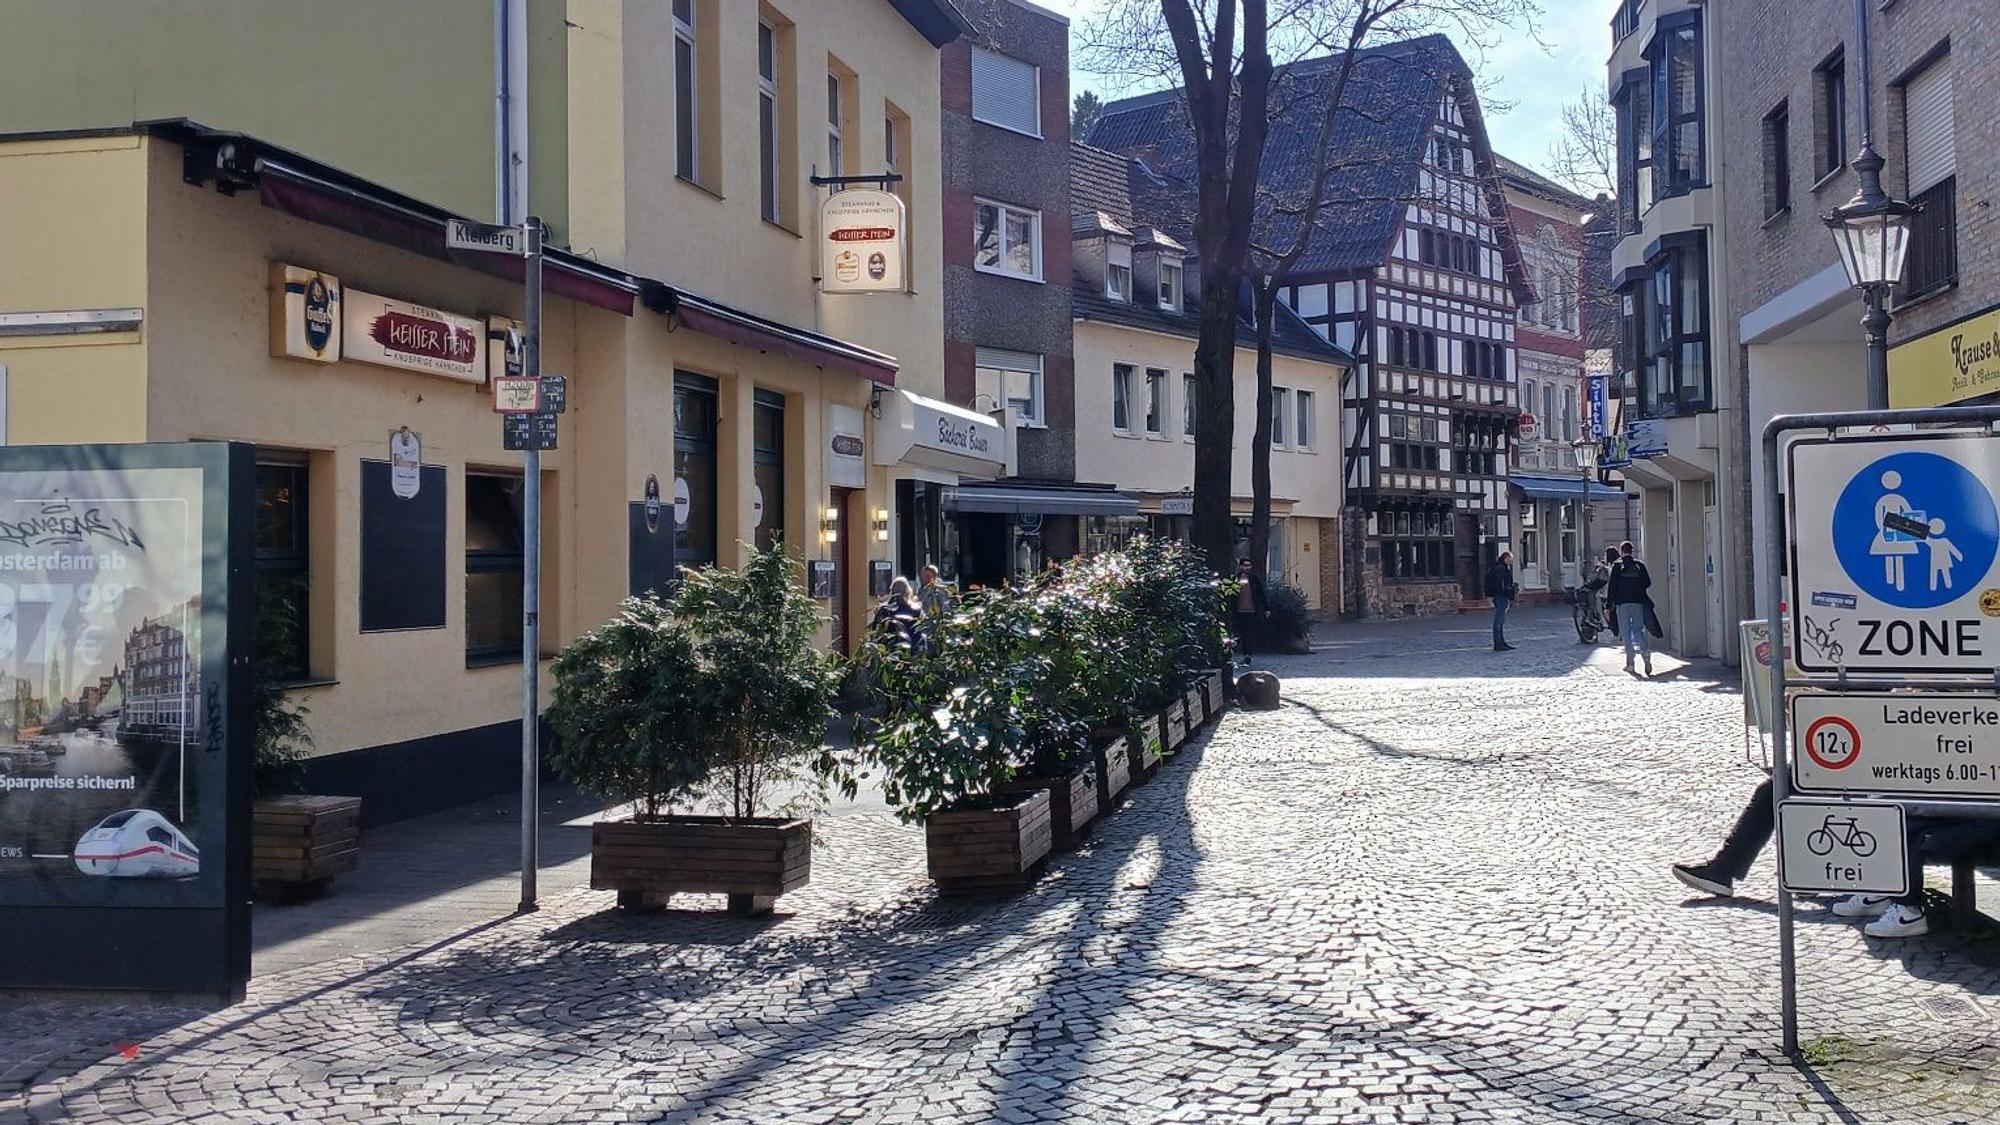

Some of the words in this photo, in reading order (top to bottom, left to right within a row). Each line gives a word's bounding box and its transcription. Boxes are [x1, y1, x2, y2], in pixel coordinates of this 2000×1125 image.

[390, 320, 441, 350] HEISSER
[442, 331, 471, 355] STEIN
[1951, 334, 1992, 375] Krause
[0, 551, 94, 571] sterdam
[99, 551, 126, 571] ab
[78, 583, 124, 613] 99
[1857, 619, 1983, 656] ZONE
[1883, 705, 1999, 726] Ladeverke
[1937, 735, 1973, 754] frei
[0, 774, 75, 791] Sparpreise
[76, 775, 136, 790] sichern!
[1872, 763, 1941, 784] werktags
[1825, 862, 1863, 881] frei
